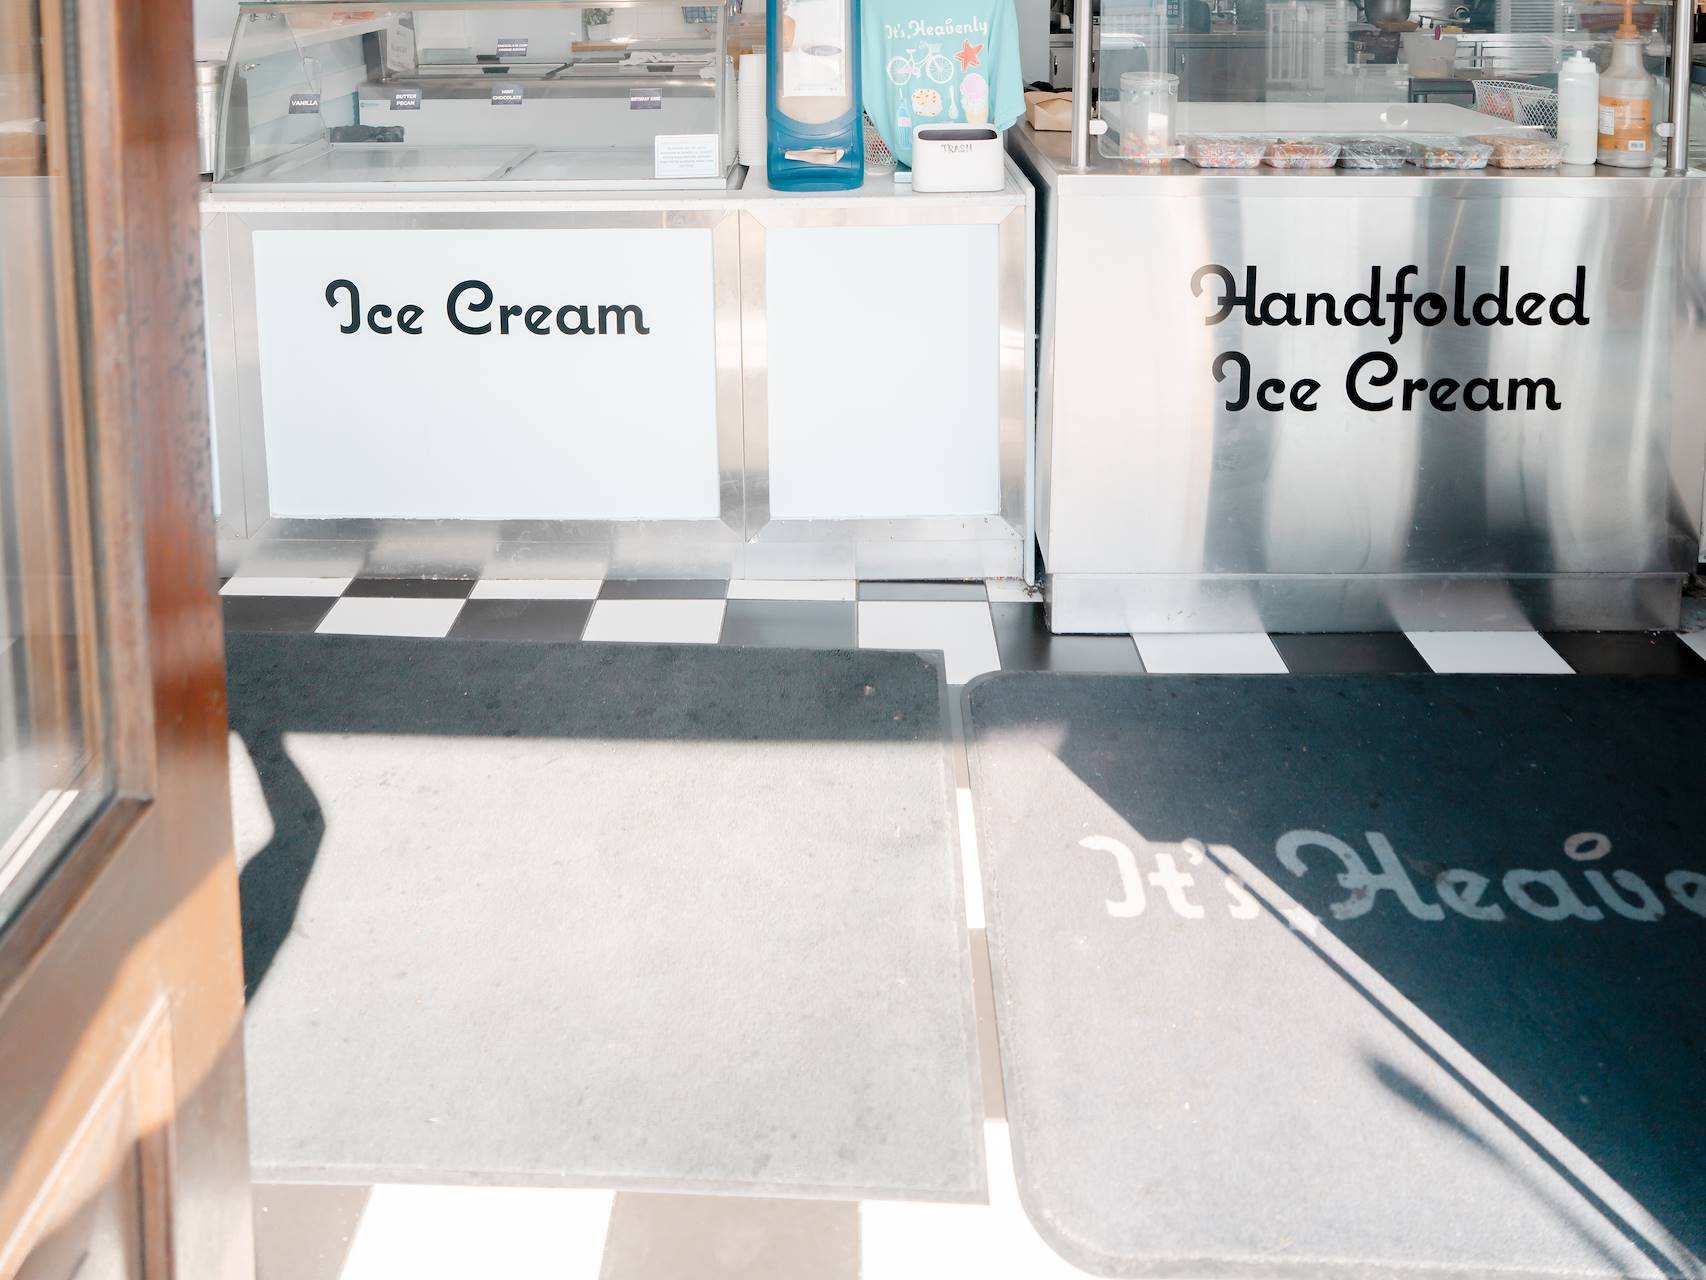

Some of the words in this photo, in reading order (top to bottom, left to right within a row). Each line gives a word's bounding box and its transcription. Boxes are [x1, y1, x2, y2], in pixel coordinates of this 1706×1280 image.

[908, 16, 987, 36] Heavenly
[325, 279, 424, 334] Ice
[446, 279, 650, 335] Cream
[1190, 264, 1590, 345] Handfolded
[1212, 351, 1321, 412] Ice
[1346, 351, 1562, 412] Cream
